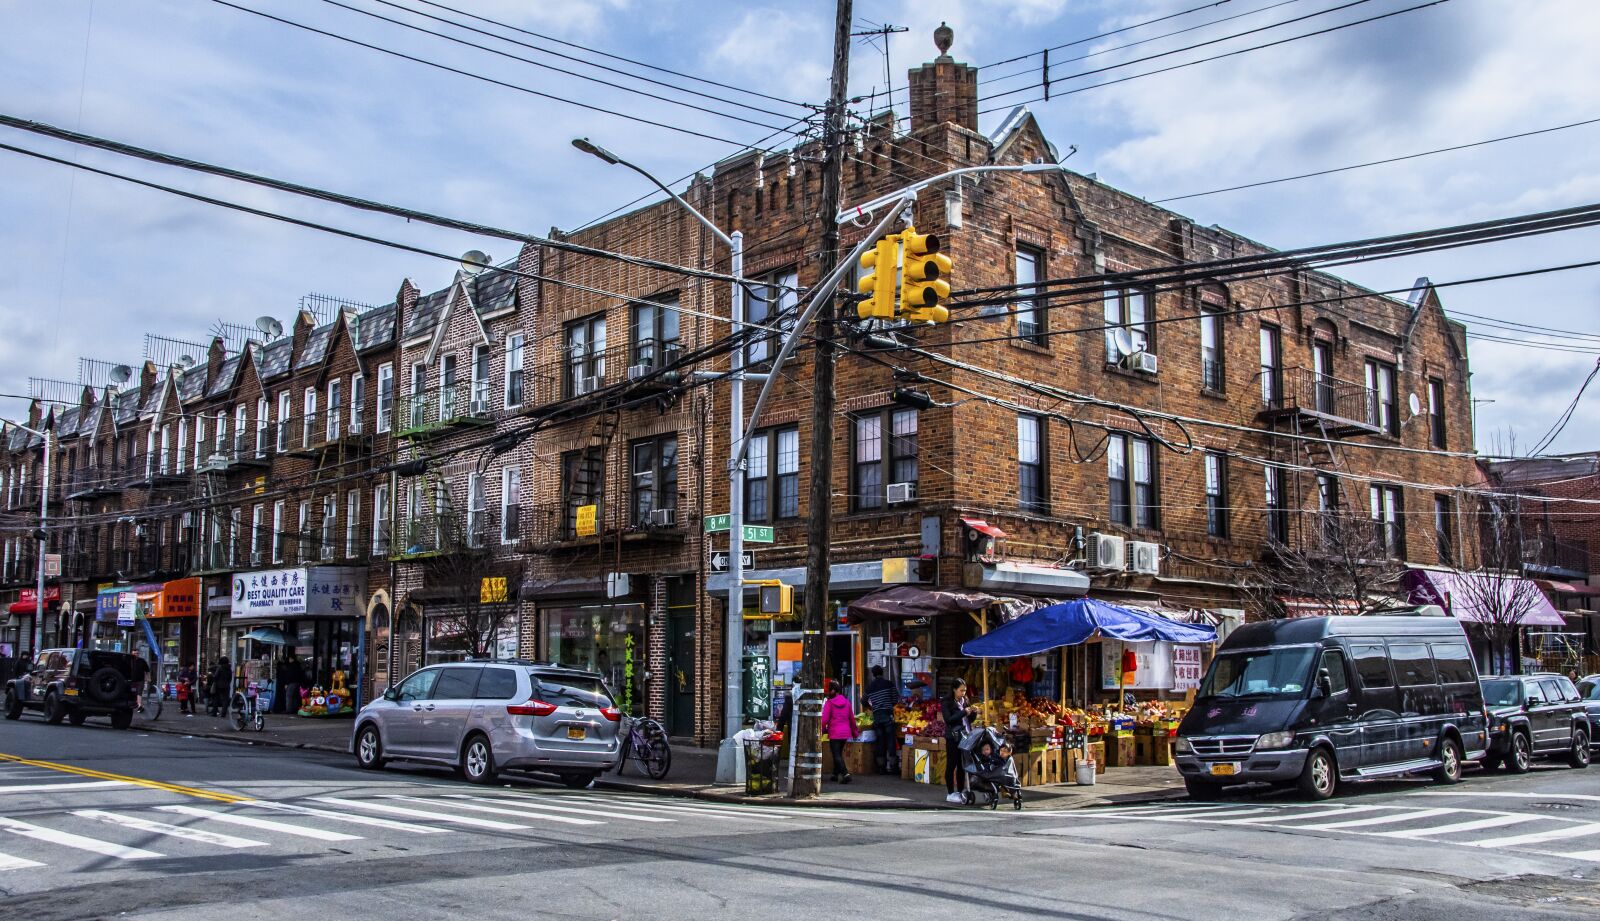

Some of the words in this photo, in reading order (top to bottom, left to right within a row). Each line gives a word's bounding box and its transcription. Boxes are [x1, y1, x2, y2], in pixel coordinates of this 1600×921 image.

[710, 518, 716, 529] 8
[718, 516, 726, 525] AV
[748, 528, 756, 540] 51
[760, 529, 768, 537] ST
[247, 590, 261, 600] BEST
[262, 588, 288, 599] QUALITY
[289, 586, 305, 597] CARE
[250, 599, 274, 608] PHARMACY
